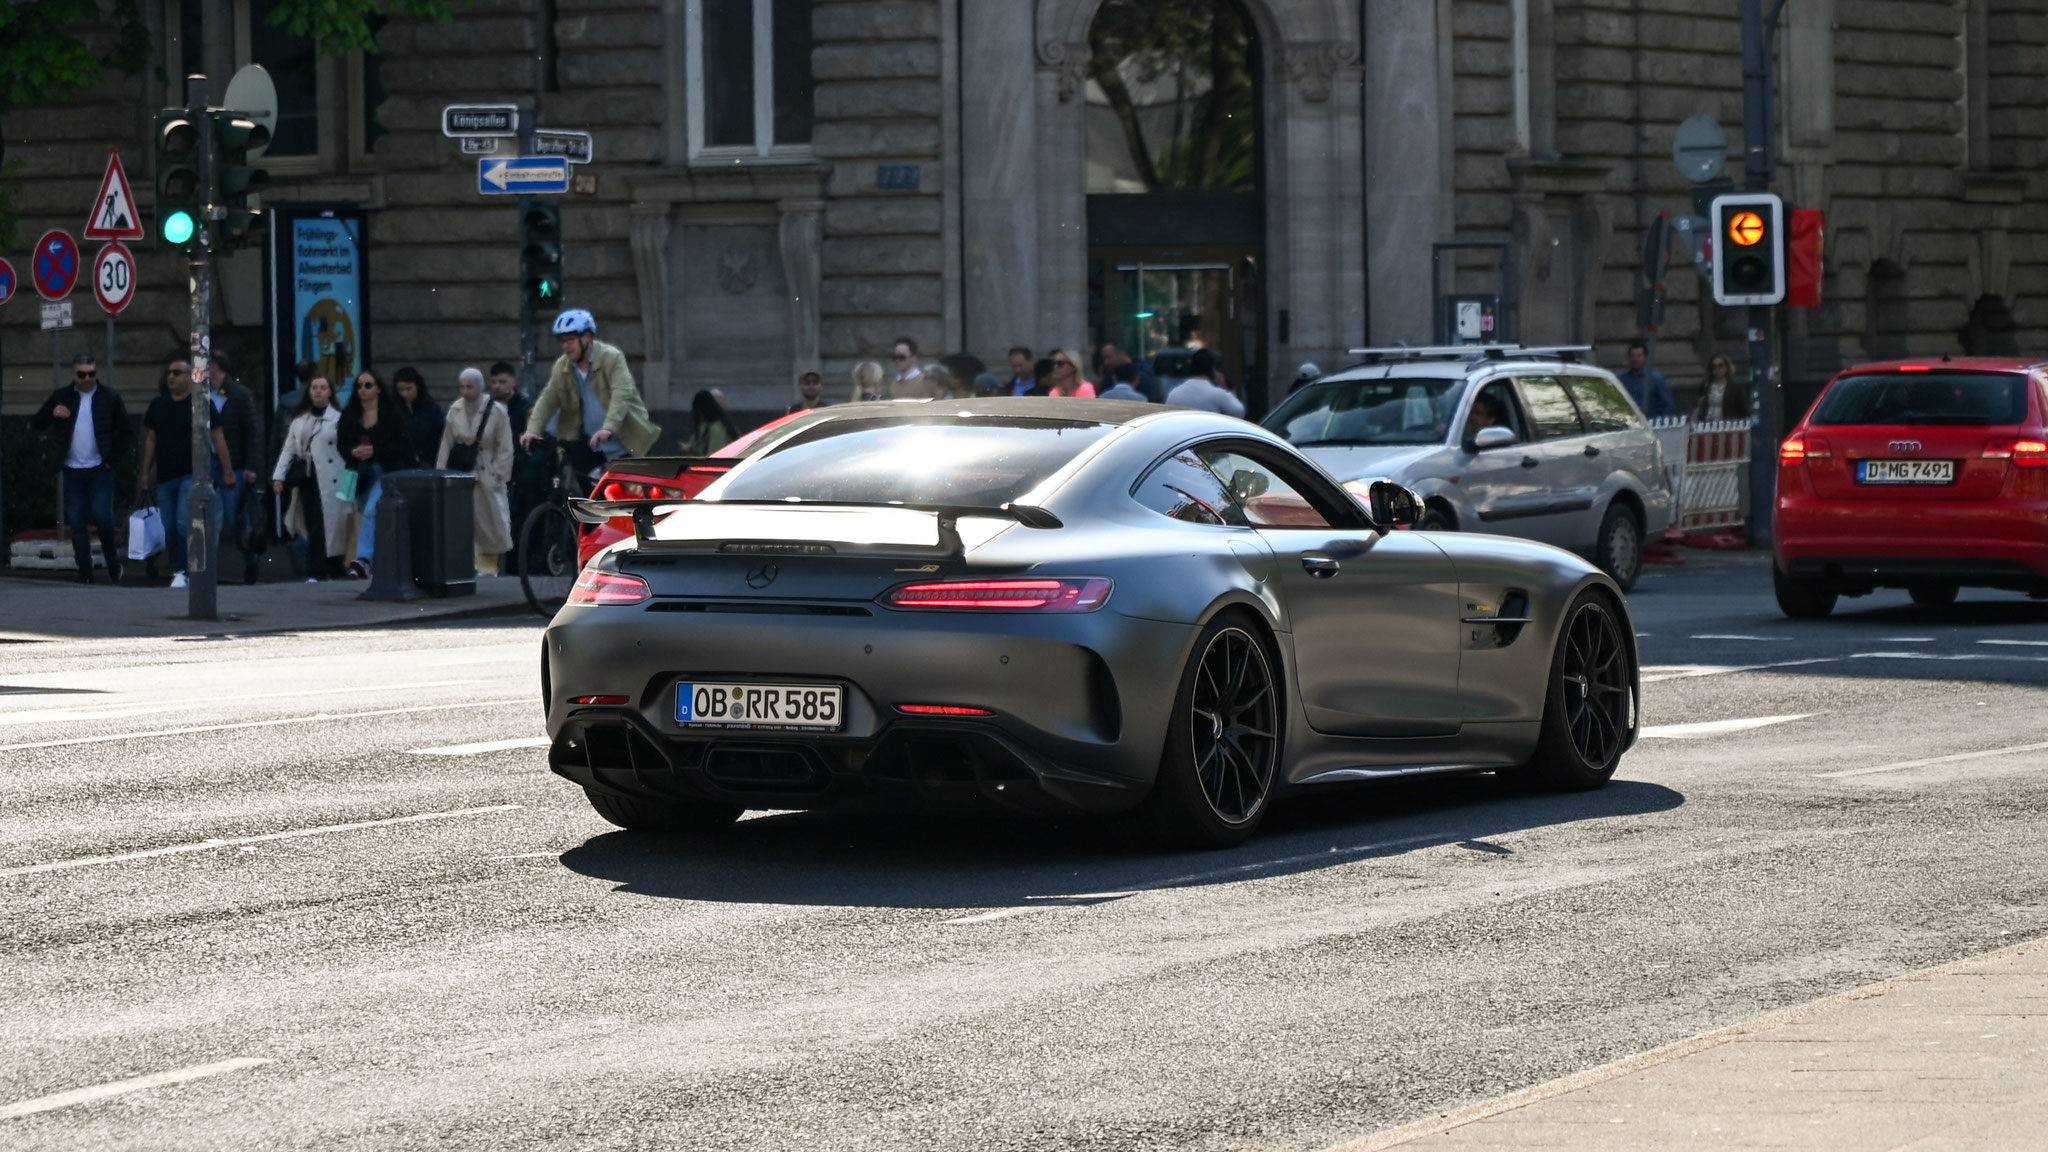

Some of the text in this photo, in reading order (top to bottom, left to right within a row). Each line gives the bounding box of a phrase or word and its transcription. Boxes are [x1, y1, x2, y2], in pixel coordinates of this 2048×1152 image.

[453, 113, 507, 130] Königsallee
[102, 260, 127, 291] 30
[298, 262, 353, 275] Allwetterbad
[1868, 463, 1951, 478] D MG 7491
[695, 688, 835, 720] OB RR 585
